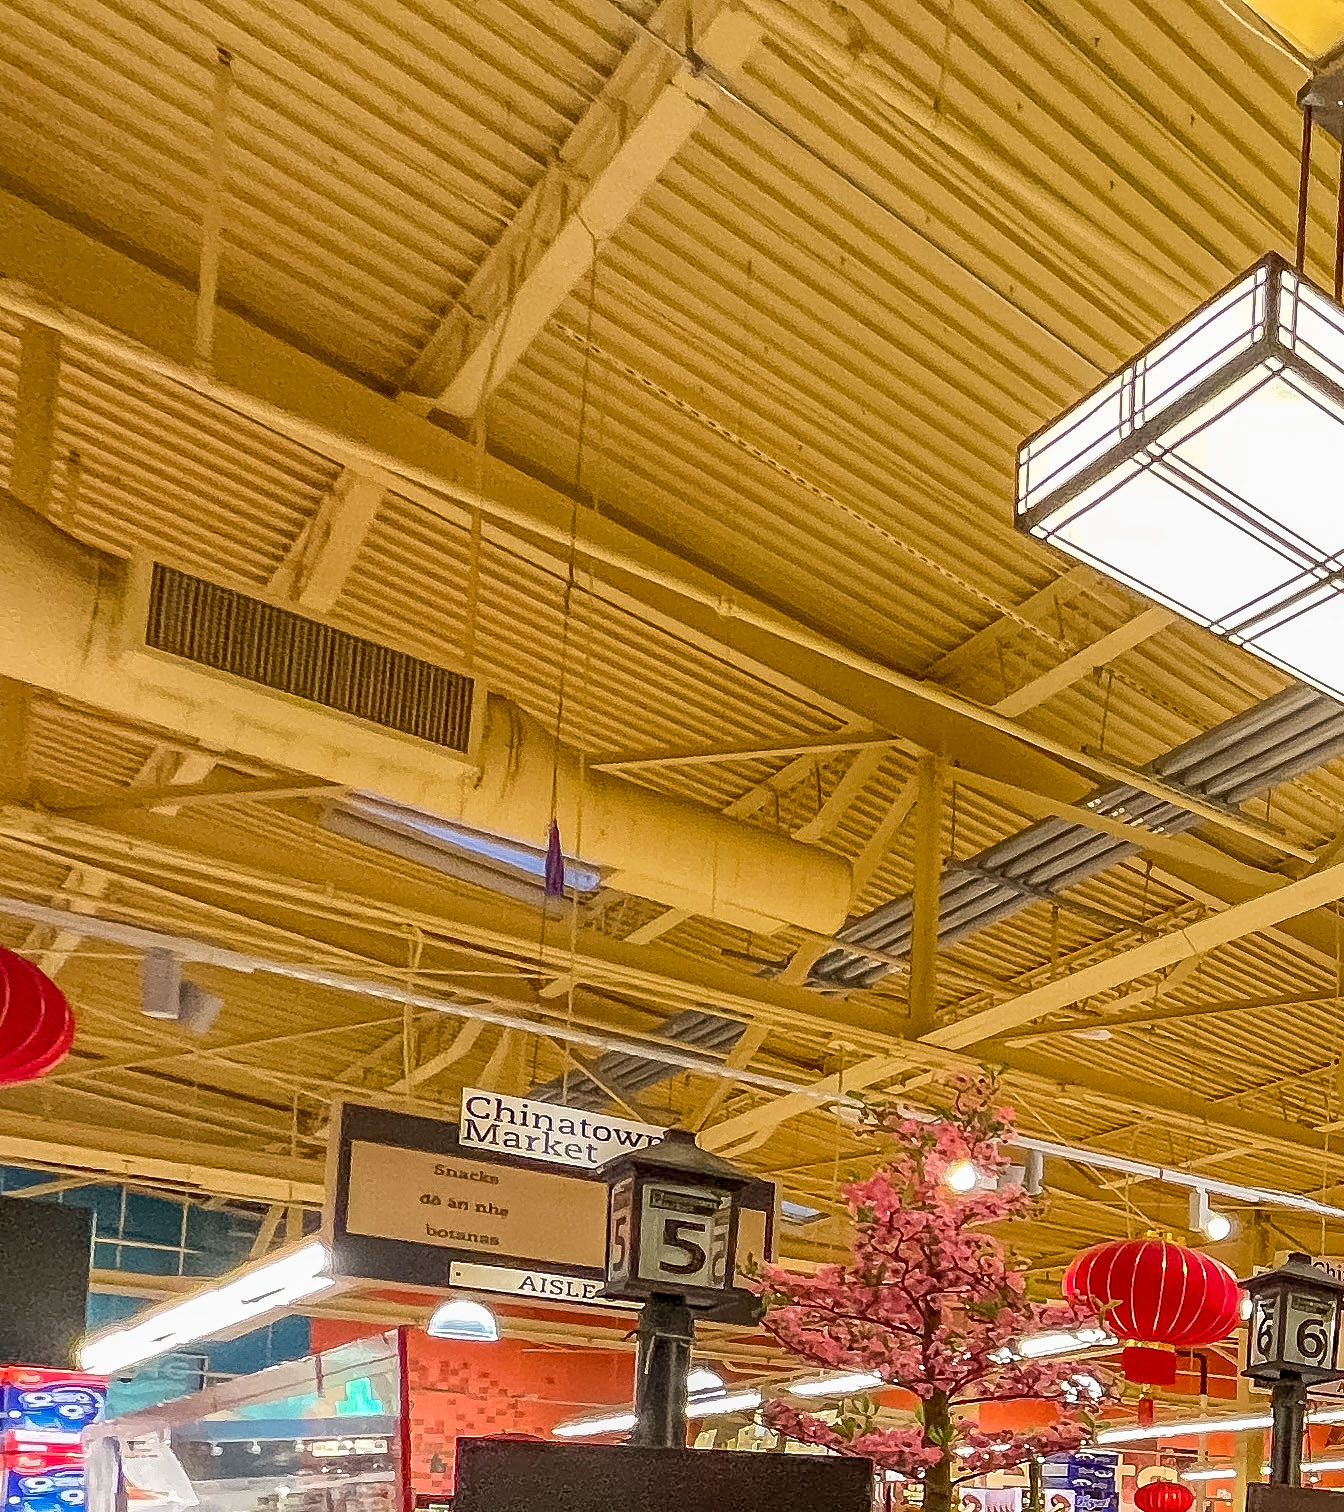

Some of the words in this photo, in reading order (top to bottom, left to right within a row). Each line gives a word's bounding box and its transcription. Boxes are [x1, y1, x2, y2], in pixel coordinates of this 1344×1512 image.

[463, 1119, 598, 1164] Market
[466, 1096, 664, 1149] Chinatown
[433, 1164, 499, 1185] Snacks
[659, 1219, 706, 1275] 5
[517, 1275, 597, 1299] AISLE
[1297, 1319, 1327, 1359] 6
